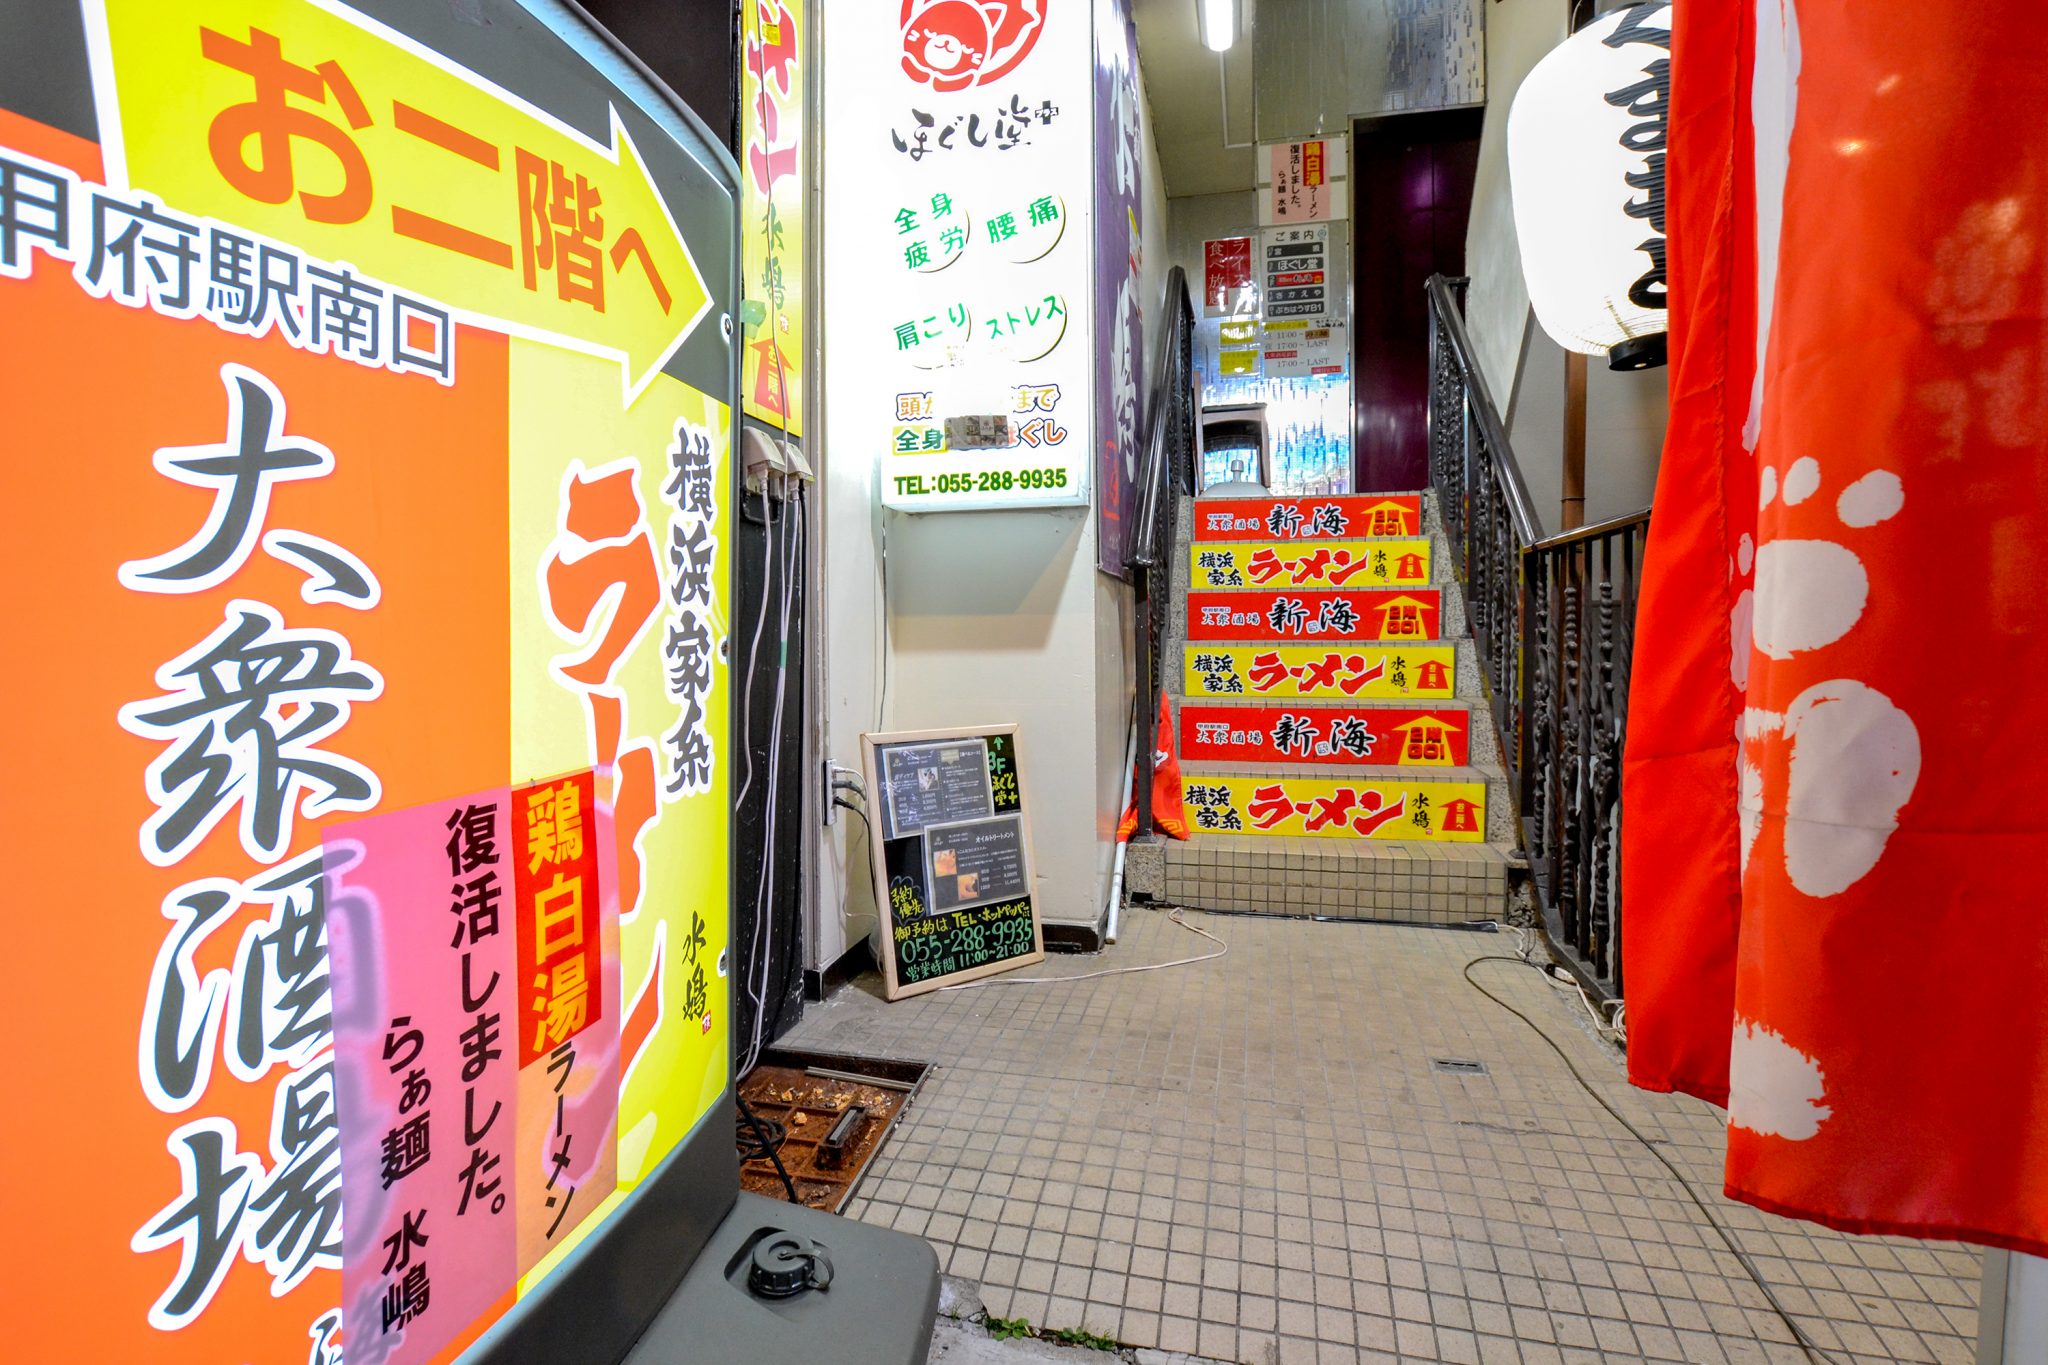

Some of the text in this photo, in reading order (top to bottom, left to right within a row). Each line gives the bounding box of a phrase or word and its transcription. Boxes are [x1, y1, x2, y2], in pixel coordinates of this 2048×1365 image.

[200, 25, 672, 316] お二階へ
[1290, 145, 1302, 208] 復活しました。
[894, 192, 953, 235] 全身
[986, 195, 1060, 244] 腰痛
[904, 226, 965, 270] 疲労
[1275, 230, 1314, 243] ご案内
[0, 158, 452, 380] 甲府駅南口
[1232, 240, 1249, 288] ライス
[1278, 258, 1319, 271] ほぐし堂
[894, 303, 966, 350] 肩こり
[986, 295, 1064, 340] ストレス
[1307, 340, 1329, 348] LAST
[1307, 358, 1330, 366] LAST
[895, 428, 944, 452] 全身
[894, 468, 1067, 495] TEL:055-288-9935
[1206, 519, 1260, 531] 大衆酒場
[1268, 504, 1348, 537] 新海
[1199, 552, 1234, 568] 横浜
[1248, 548, 1369, 586] ラーメン
[1207, 568, 1243, 586] 家系
[666, 427, 714, 793] 横浜家系
[1202, 613, 1260, 625] 大衆酒場
[1269, 597, 1359, 635] 新海
[1193, 654, 1234, 672] 横浜
[1248, 651, 1386, 695] ラーメン
[1203, 673, 1244, 694] 家系
[1196, 730, 1263, 744] 大衆酒場
[1272, 714, 1377, 757] 新海
[1184, 785, 1232, 806] 横浜
[1248, 784, 1408, 835] ラーメン
[1196, 807, 1243, 831] 家系
[891, 886, 912, 908] 予約
[899, 898, 925, 921] 優先
[895, 919, 949, 942] 御予約は
[902, 919, 1032, 964] 055-288-9935
[682, 910, 710, 1021] 水嶋
[905, 957, 955, 983] 営業時間
[445, 803, 506, 1216] 復活しました。
[381, 1016, 432, 1335] らぁ麺 水嶋
